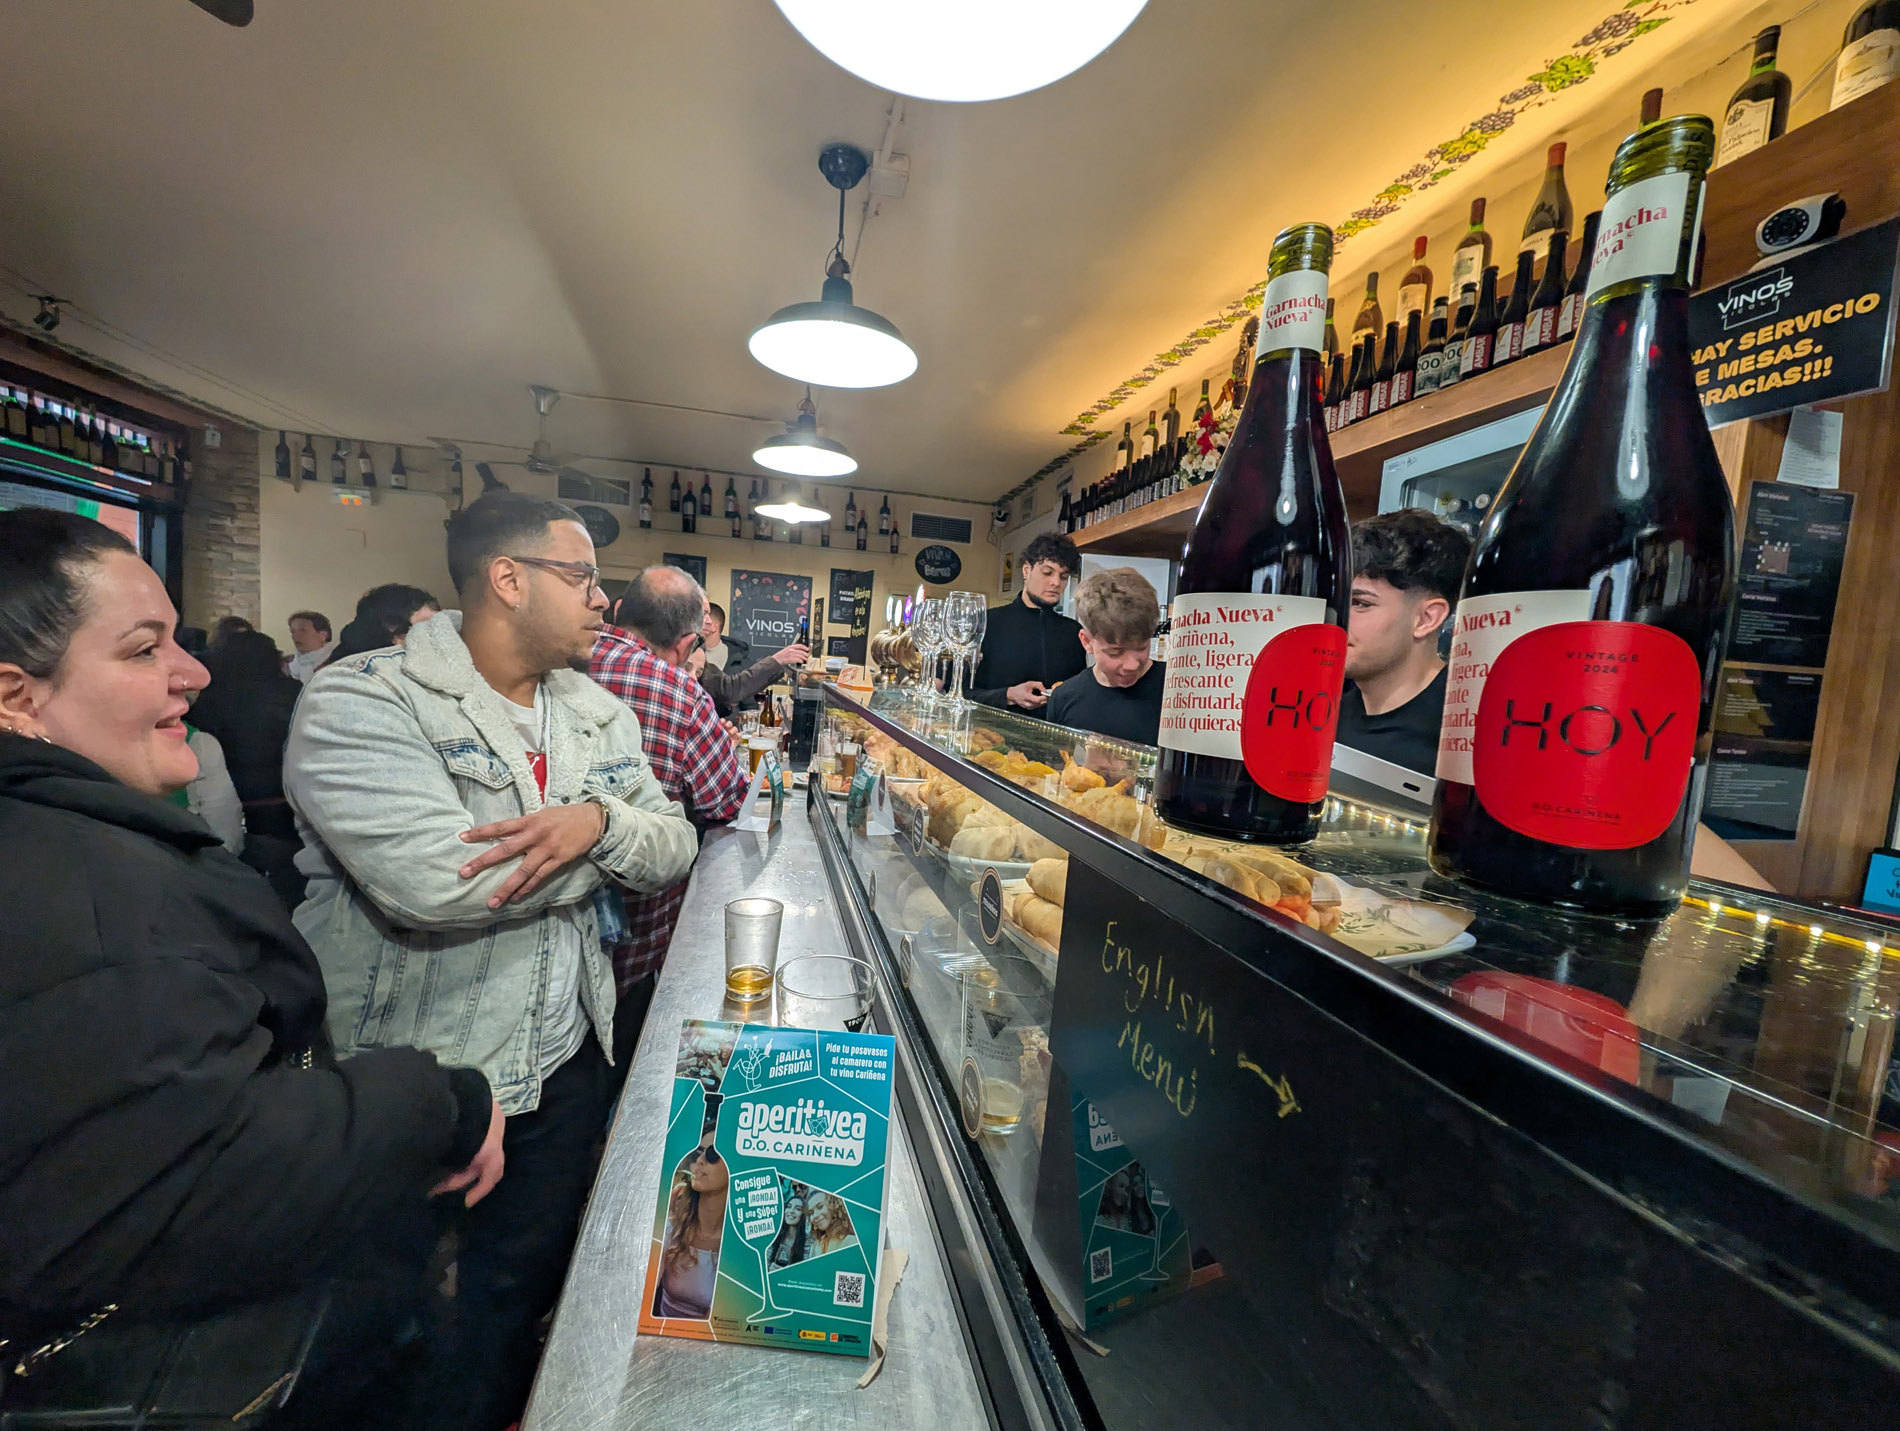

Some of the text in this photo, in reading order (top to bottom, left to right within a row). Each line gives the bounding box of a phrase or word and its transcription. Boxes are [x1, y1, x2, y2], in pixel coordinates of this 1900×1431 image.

[1717, 275, 1795, 315] VINOS
[1266, 293, 1326, 319] Garnacha
[1266, 311, 1308, 330] Nueva
[1541, 307, 1554, 342] AMBAR
[1738, 293, 1881, 351] SERVICIO
[1511, 323, 1524, 357] AMBAR
[1474, 335, 1487, 369] AMBAR
[1717, 338, 1824, 381] MESAS.
[1379, 381, 1388, 409] AMBAR
[1399, 371, 1409, 400] AMBAR
[1356, 391, 1365, 417] AMBAR
[745, 618, 795, 633] VINOS
[1216, 607, 1274, 623] Nueva
[1462, 610, 1512, 633] Nueva
[1173, 630, 1235, 649] Cariñena,
[1205, 650, 1254, 671] ligera
[1565, 651, 1640, 663] VINTAGE
[1173, 692, 1244, 710] disfrutarla
[1500, 700, 1678, 761] HOY
[826, 1042, 888, 1058] Pide tu posavasos
[769, 1060, 813, 1079] DISFRUTA!
[831, 1055, 887, 1069] al camarero con
[830, 1067, 886, 1081] tu vino Cariñena
[738, 1098, 867, 1141] aperitivea
[742, 1139, 857, 1160] D.O. CARIÑENA
[734, 1173, 771, 1192] Consigue
[749, 1191, 777, 1204] ¡RONDA!
[746, 1220, 774, 1238] ¡RONDA!
